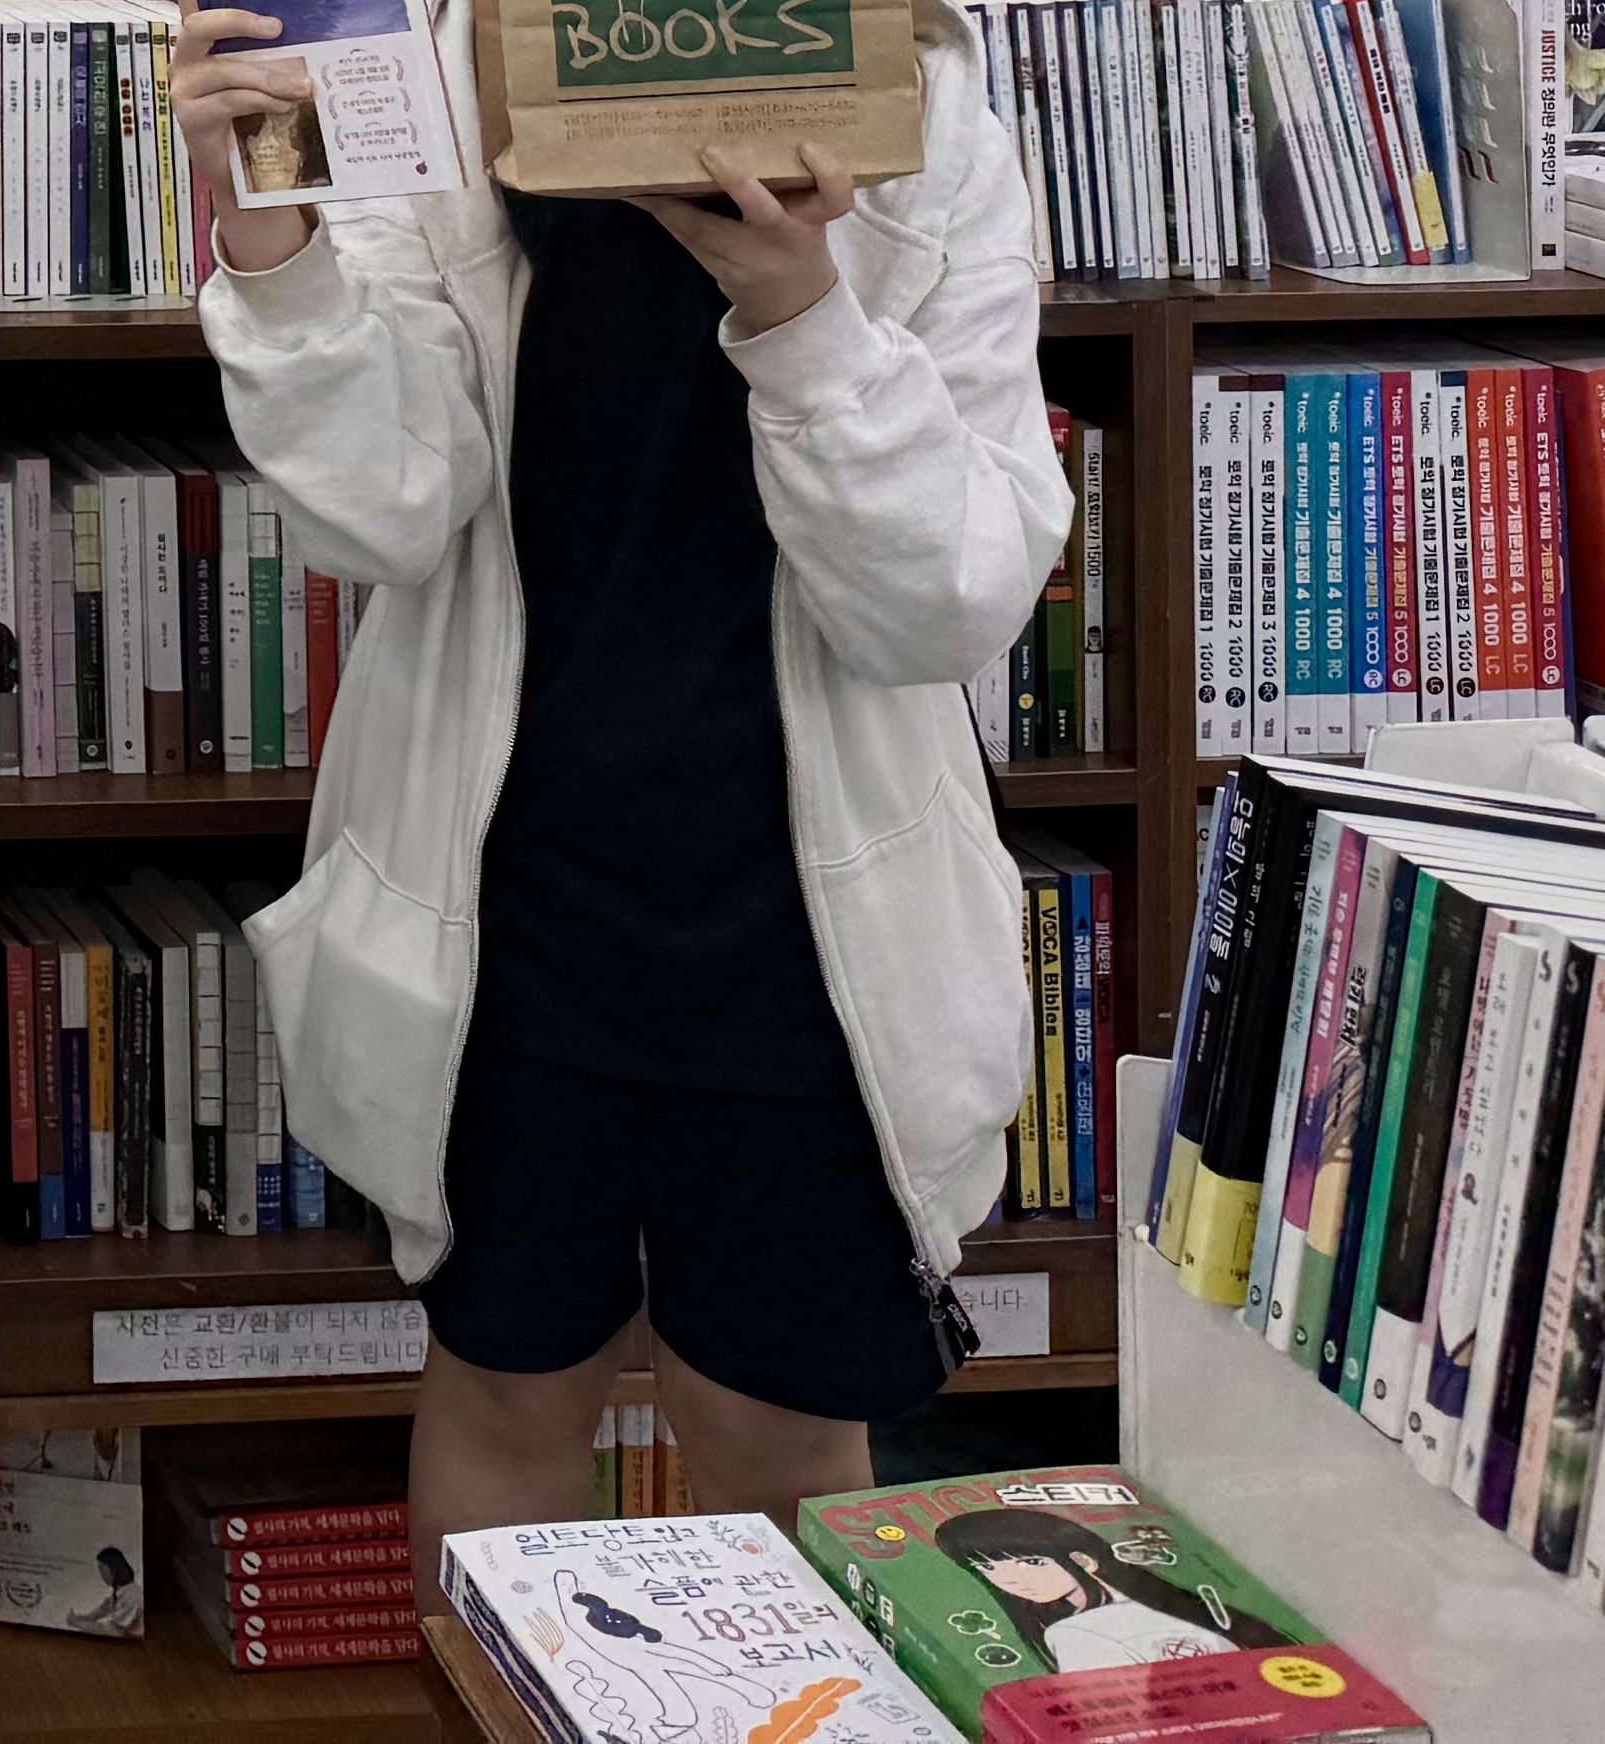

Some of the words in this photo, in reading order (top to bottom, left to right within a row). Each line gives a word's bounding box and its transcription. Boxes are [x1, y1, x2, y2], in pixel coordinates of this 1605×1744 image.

[1541, 29, 1556, 84] JUSTICE
[1540, 87, 1557, 127] 정의란
[1540, 131, 1557, 187] 무엇인가
[1198, 623, 1214, 631] 1
[1262, 620, 1276, 631] 3
[1425, 614, 1440, 623] 1
[1198, 642, 1214, 683] 1000
[1261, 636, 1277, 684] 1000
[1426, 631, 1442, 672] 1000
[1199, 687, 1216, 703] RC
[1260, 682, 1277, 701] RC
[1427, 678, 1443, 693] LC
[1041, 906, 1058, 966] VOCA
[161, 1345, 226, 1370] 신중한
[994, 1482, 1142, 1507] 스티커
[634, 1574, 725, 1607] 슬픔에
[733, 1569, 796, 1597] 관한
[738, 1638, 841, 1670] 보고서
